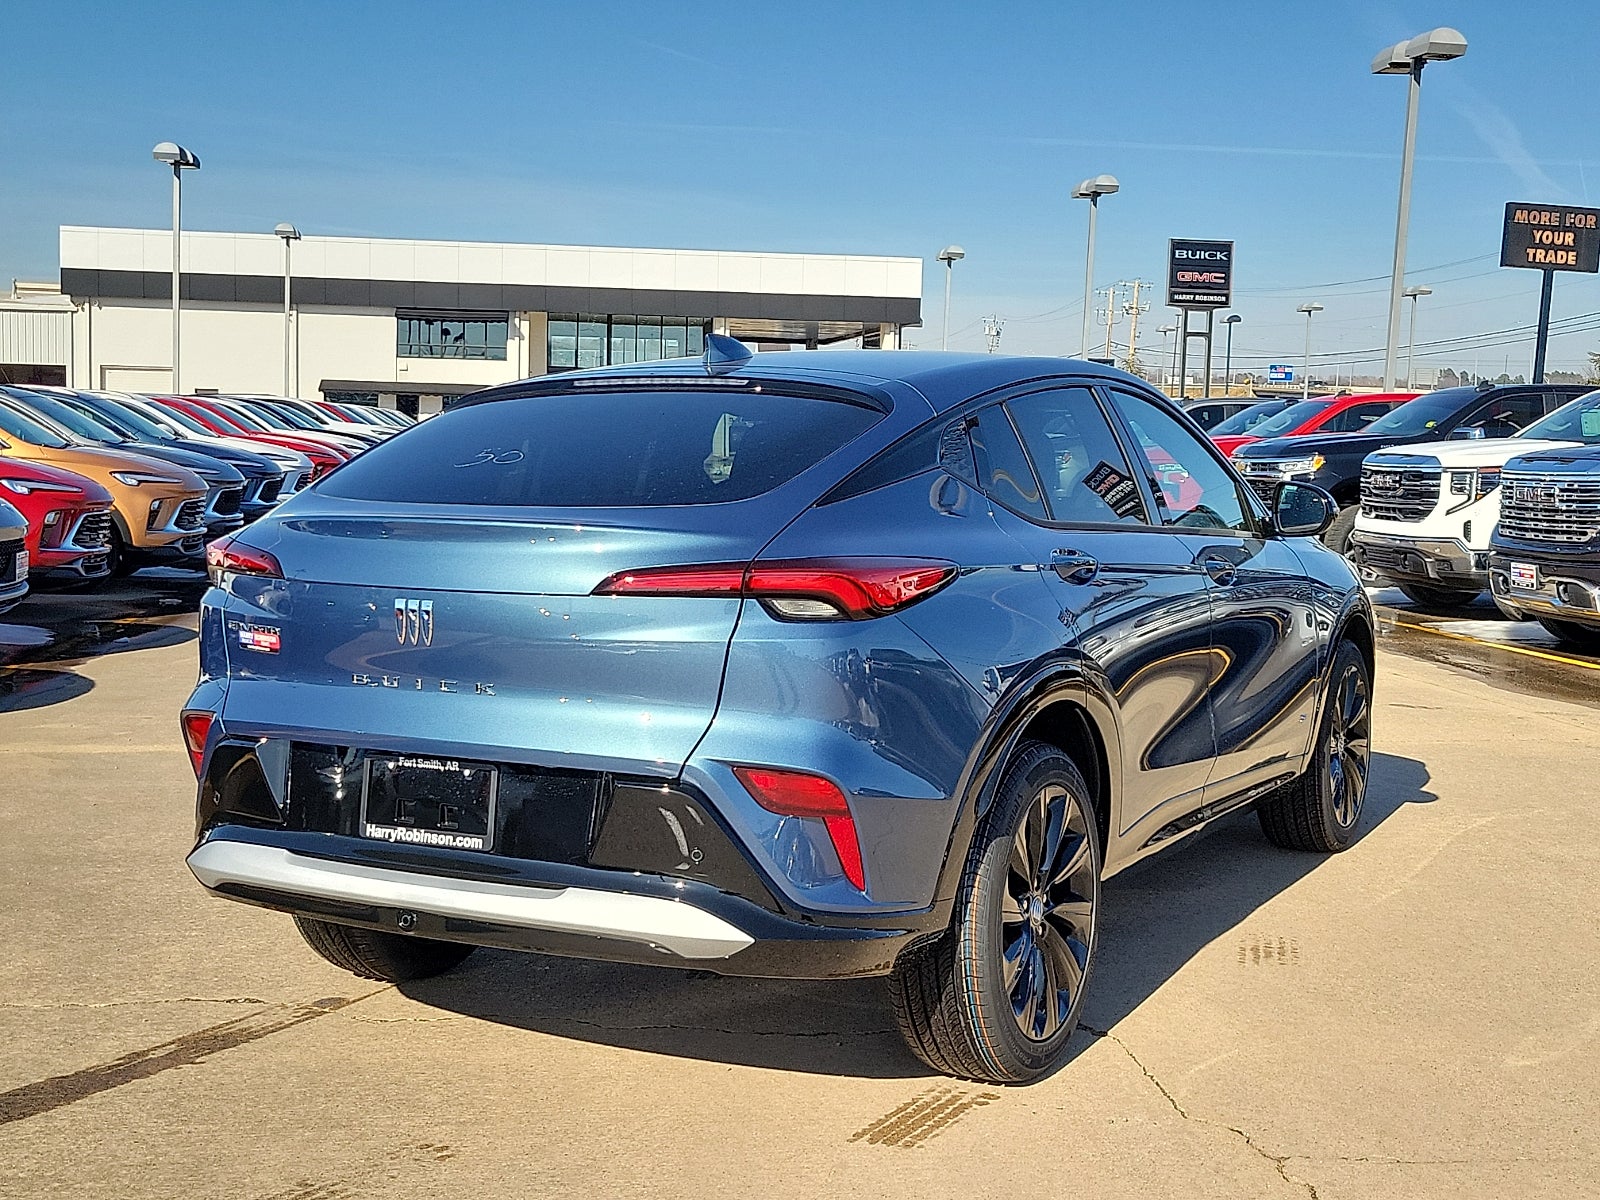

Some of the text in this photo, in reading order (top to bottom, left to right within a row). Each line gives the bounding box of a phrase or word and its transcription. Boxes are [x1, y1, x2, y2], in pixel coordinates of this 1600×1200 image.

[1514, 210, 1597, 228] MORE FOR
[1533, 230, 1575, 246] YOUR
[1175, 250, 1230, 261] BUICK
[1526, 248, 1577, 265] TRADE
[1177, 271, 1226, 283] GMC
[1515, 486, 1556, 503] GMC
[352, 673, 496, 696] BUICK
[398, 757, 460, 772] Fort Smith, AR
[366, 824, 483, 849] HarryRobinson.com
